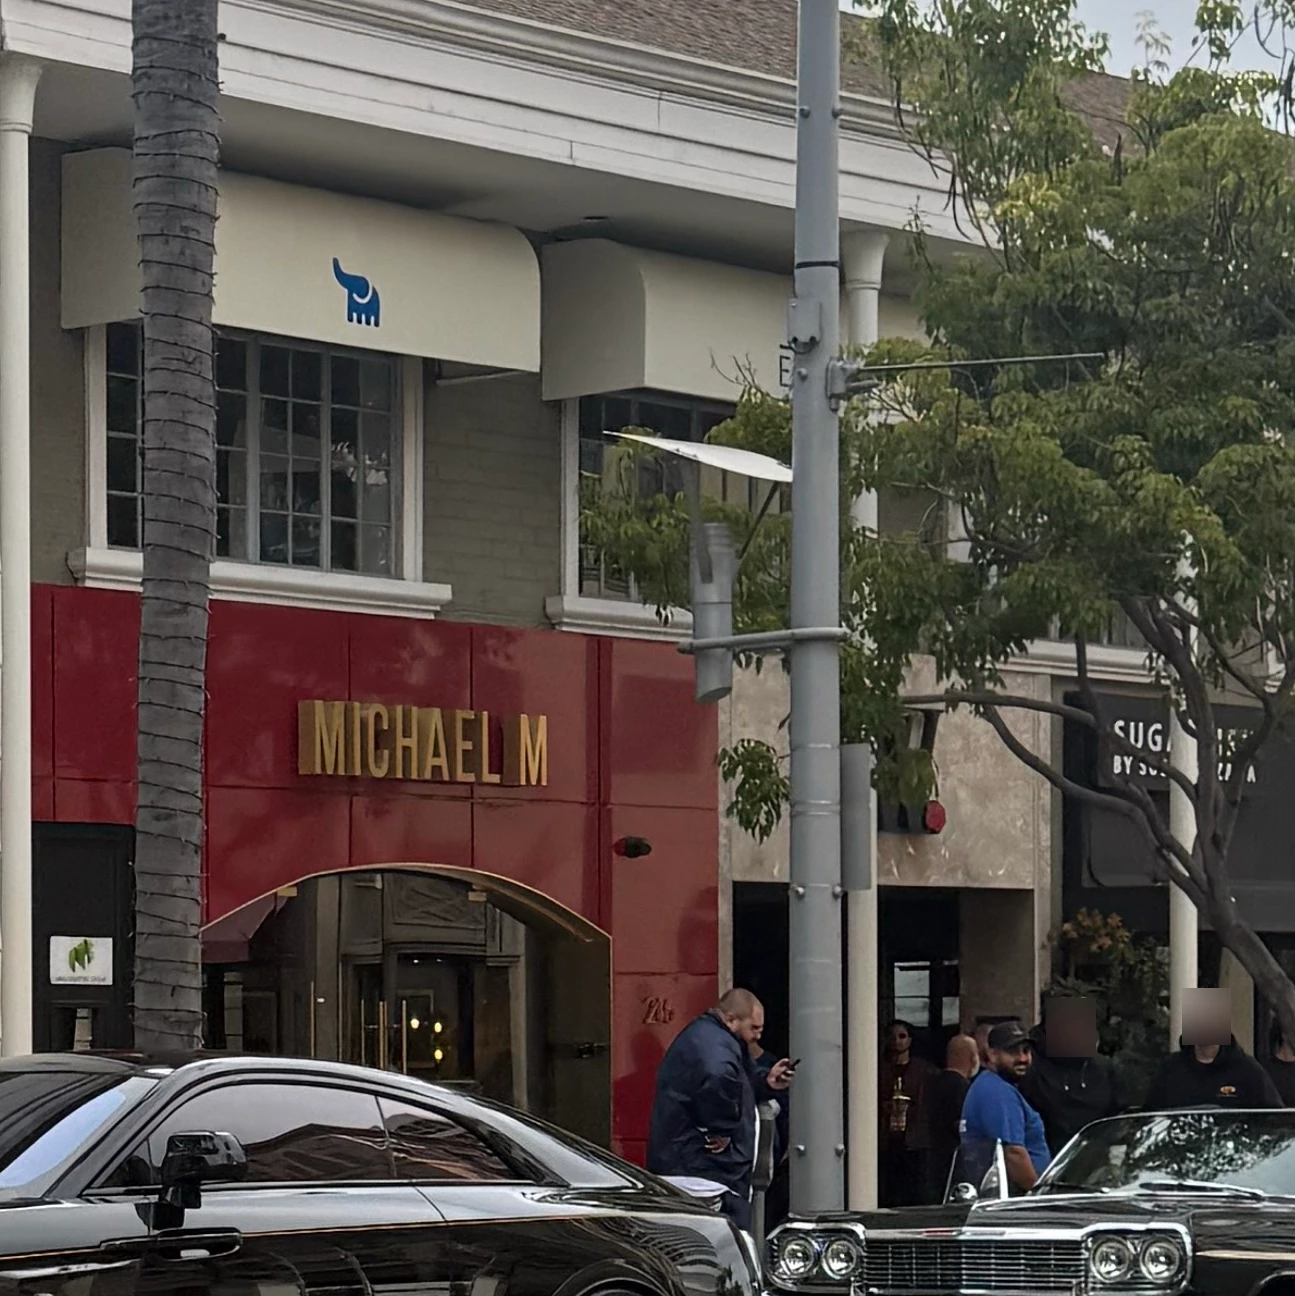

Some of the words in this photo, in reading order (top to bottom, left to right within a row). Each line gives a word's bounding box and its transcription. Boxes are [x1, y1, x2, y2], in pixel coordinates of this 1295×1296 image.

[313, 700, 501, 783] MICHAEL
[519, 715, 549, 786] M
[1113, 755, 1133, 775] BY
